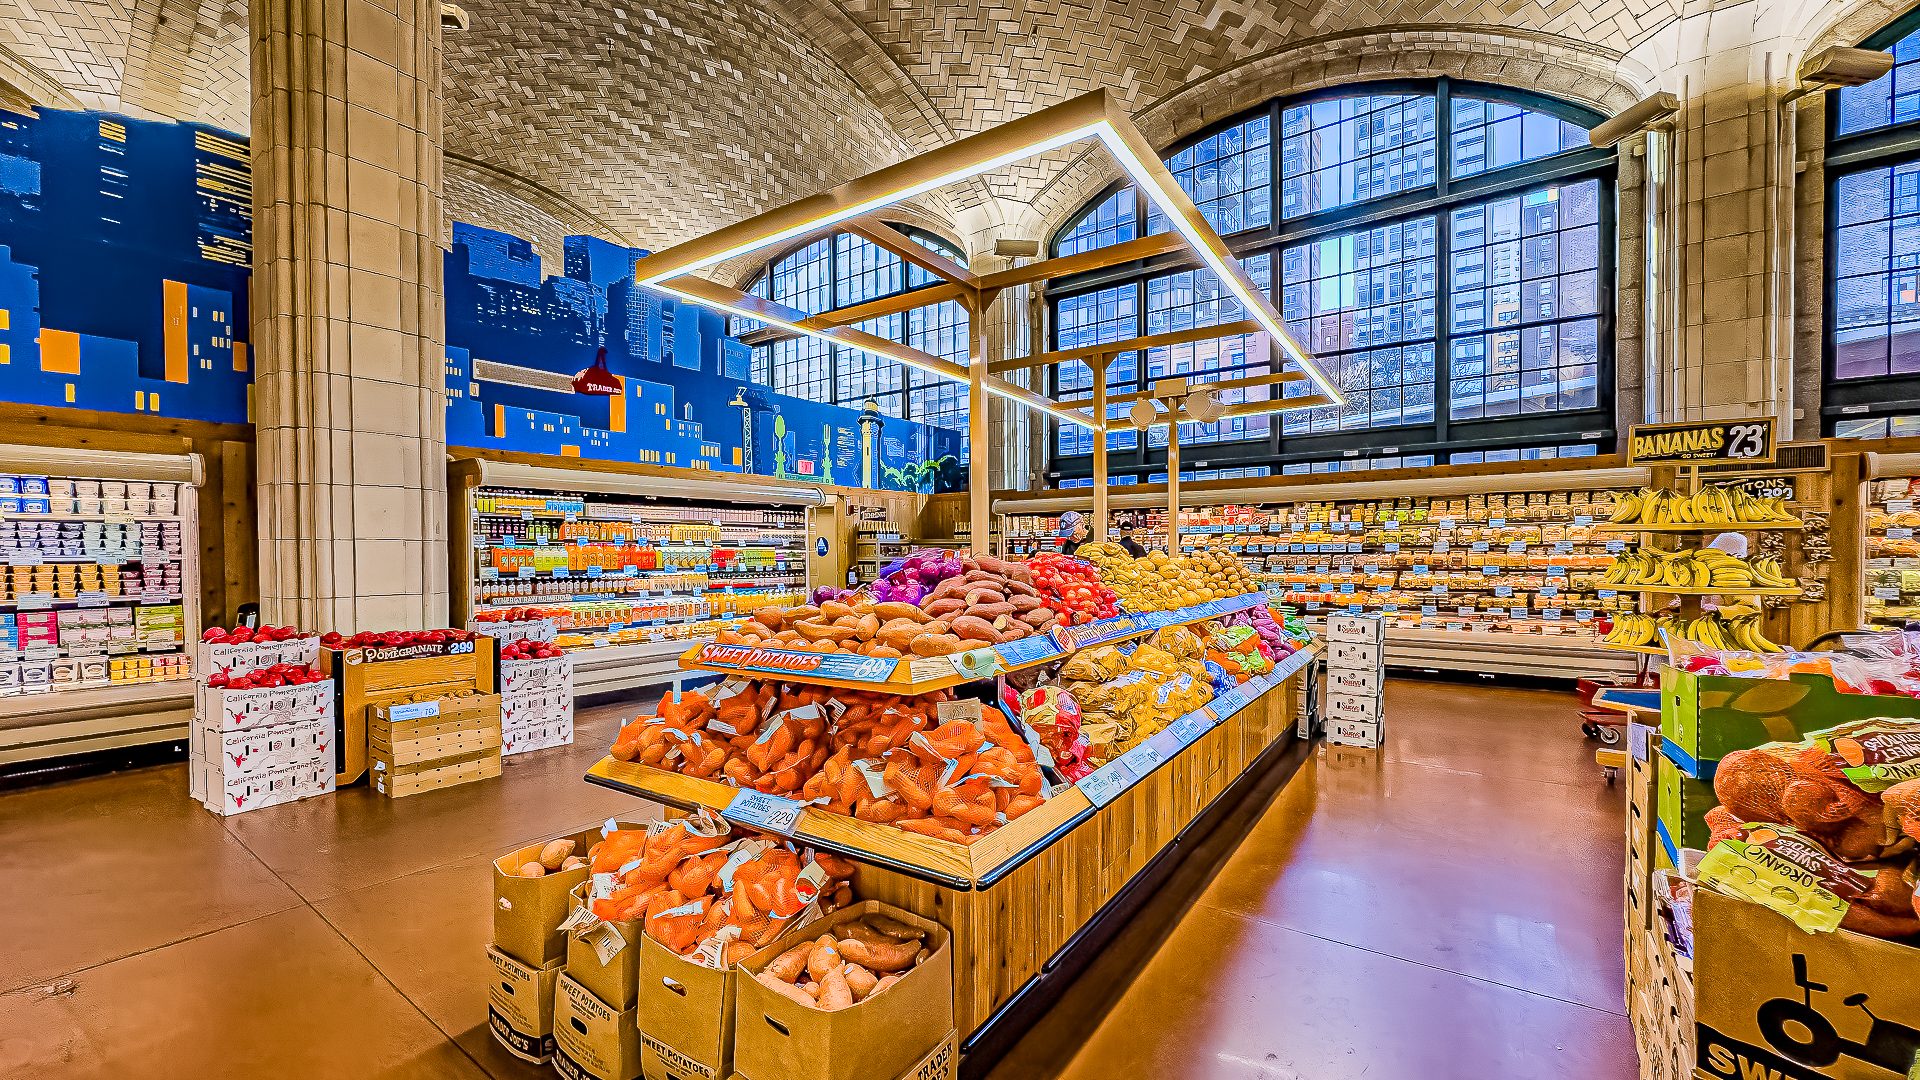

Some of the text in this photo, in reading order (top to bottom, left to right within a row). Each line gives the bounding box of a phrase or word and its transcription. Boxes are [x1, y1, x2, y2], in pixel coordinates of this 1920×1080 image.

[1634, 427, 1725, 457] BANANAS
[213, 640, 307, 656] California Pomegranates
[365, 644, 443, 663] POMEGRANATE
[703, 644, 750, 663] SWEET
[744, 649, 823, 671] POTATOES
[227, 682, 322, 703] California Pomegranates
[226, 721, 321, 746] California Pomegranates
[227, 759, 322, 787] California Pomegranates
[740, 800, 772, 813] POTATOES
[750, 795, 772, 805] SWEET
[1748, 847, 1814, 888] ORGANIC
[1774, 846, 1820, 872] SWEET
[505, 960, 531, 982] POTATOES
[560, 979, 581, 999] SWEET
[581, 991, 611, 1022] POTATOES
[642, 1034, 665, 1056] SWEET
[667, 1047, 709, 1079] POTATOES
